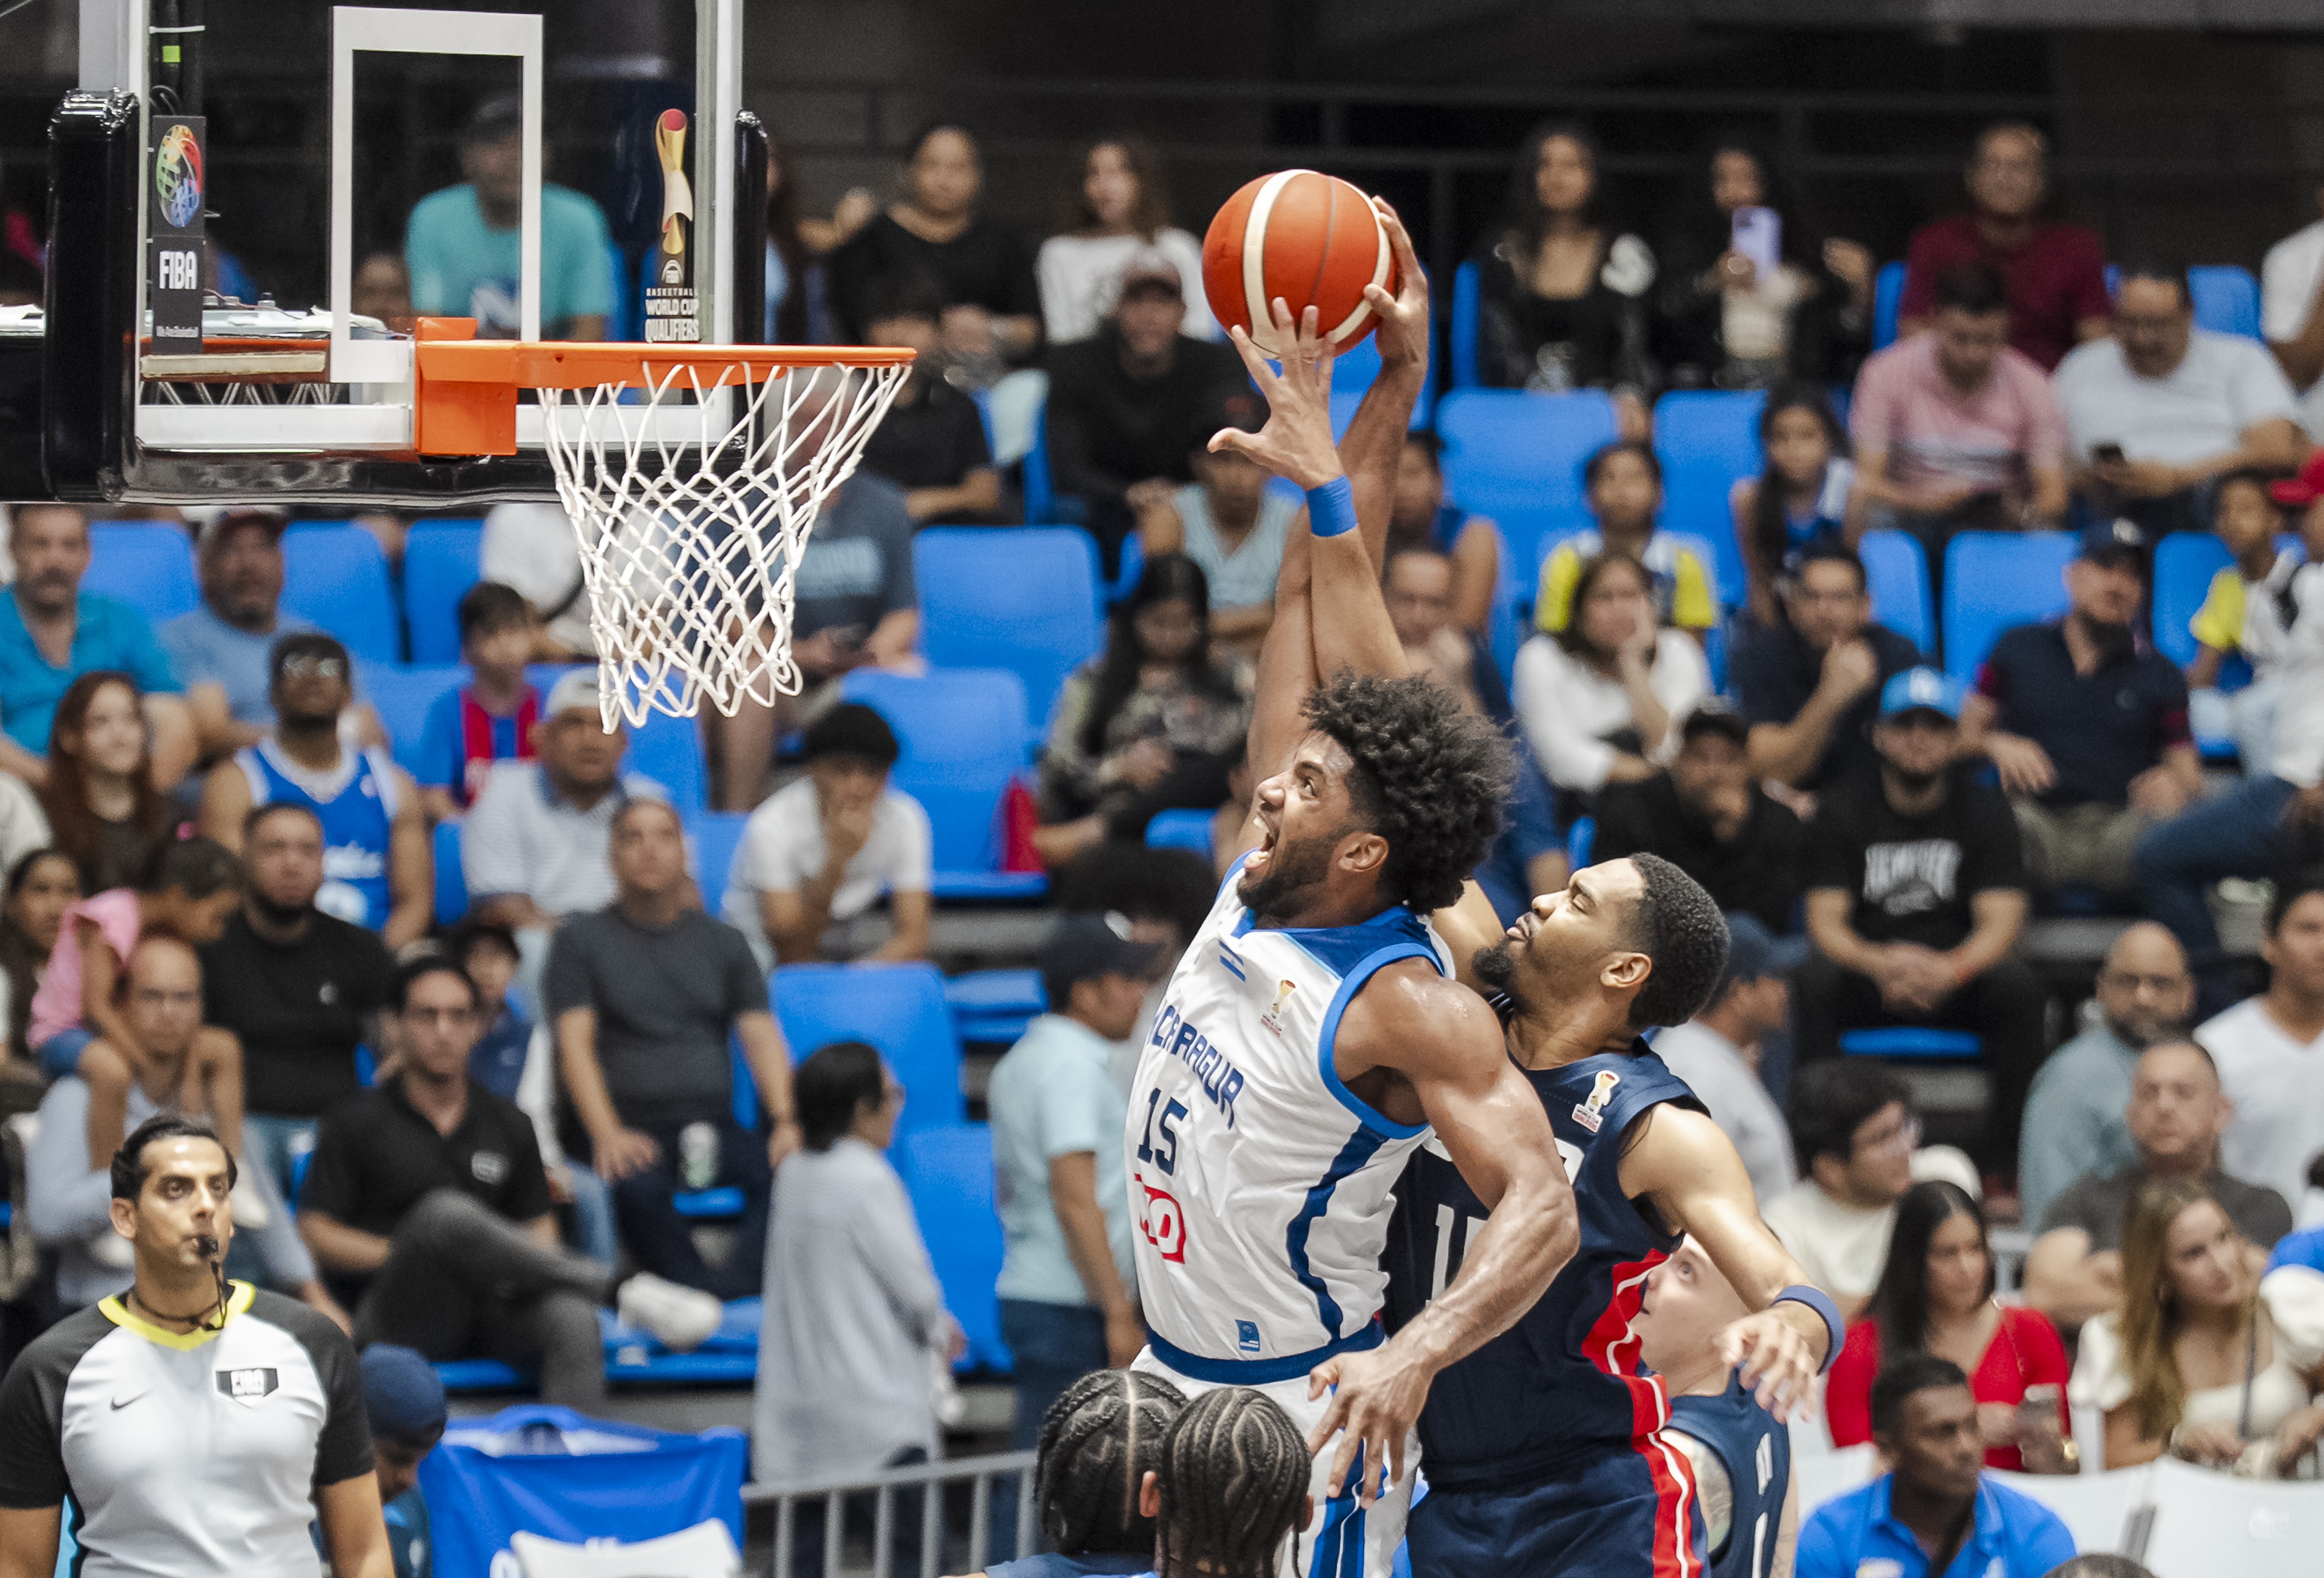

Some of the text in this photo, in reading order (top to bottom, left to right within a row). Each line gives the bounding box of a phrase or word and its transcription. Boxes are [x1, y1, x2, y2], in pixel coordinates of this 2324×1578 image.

[159, 250, 197, 289] FIBA
[645, 298, 700, 316] WORLD CUP
[646, 288, 699, 296] BASKETBALL
[644, 318, 700, 343] QUALIFIERS
[1151, 1004, 1244, 1130] CARAGUA
[1137, 1087, 1189, 1176] 15
